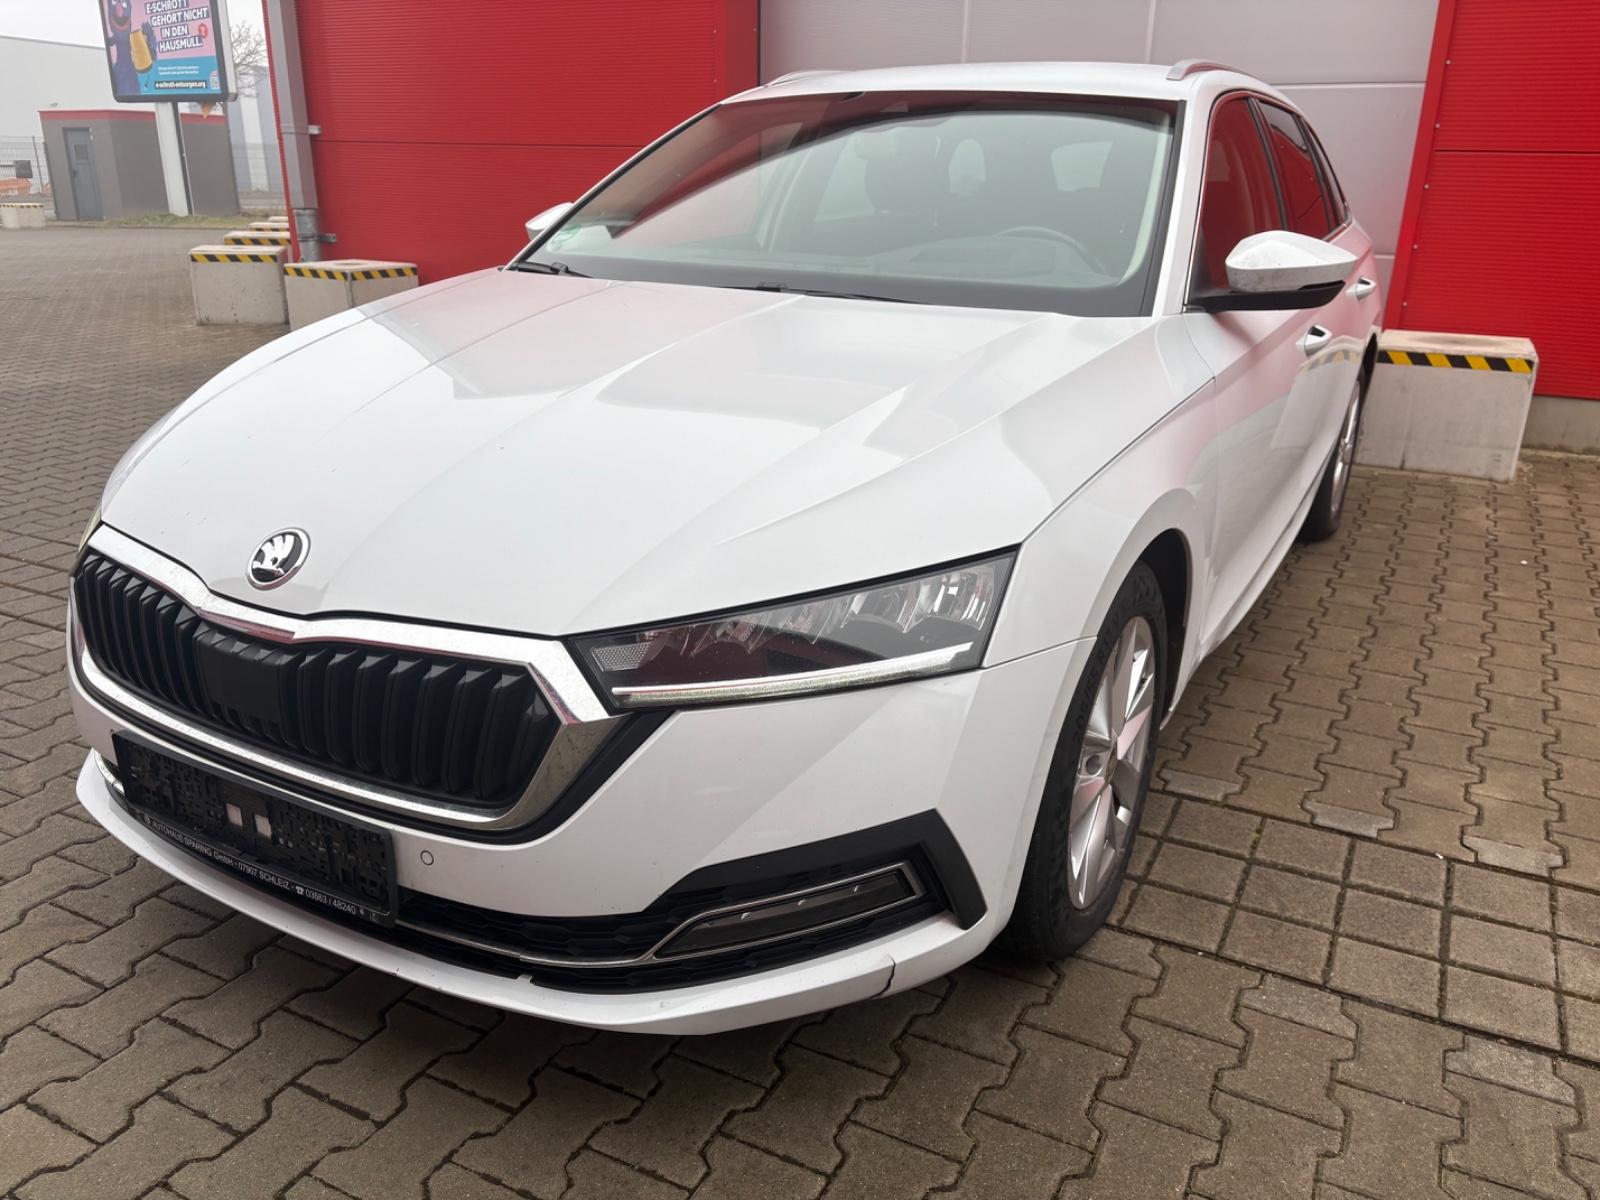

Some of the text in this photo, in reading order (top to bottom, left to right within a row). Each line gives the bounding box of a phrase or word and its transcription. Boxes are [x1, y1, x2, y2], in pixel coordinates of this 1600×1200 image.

[146, 0, 187, 14] E-SCHROTT
[183, 7, 208, 21] NICHT
[161, 25, 188, 38] IN DEN
